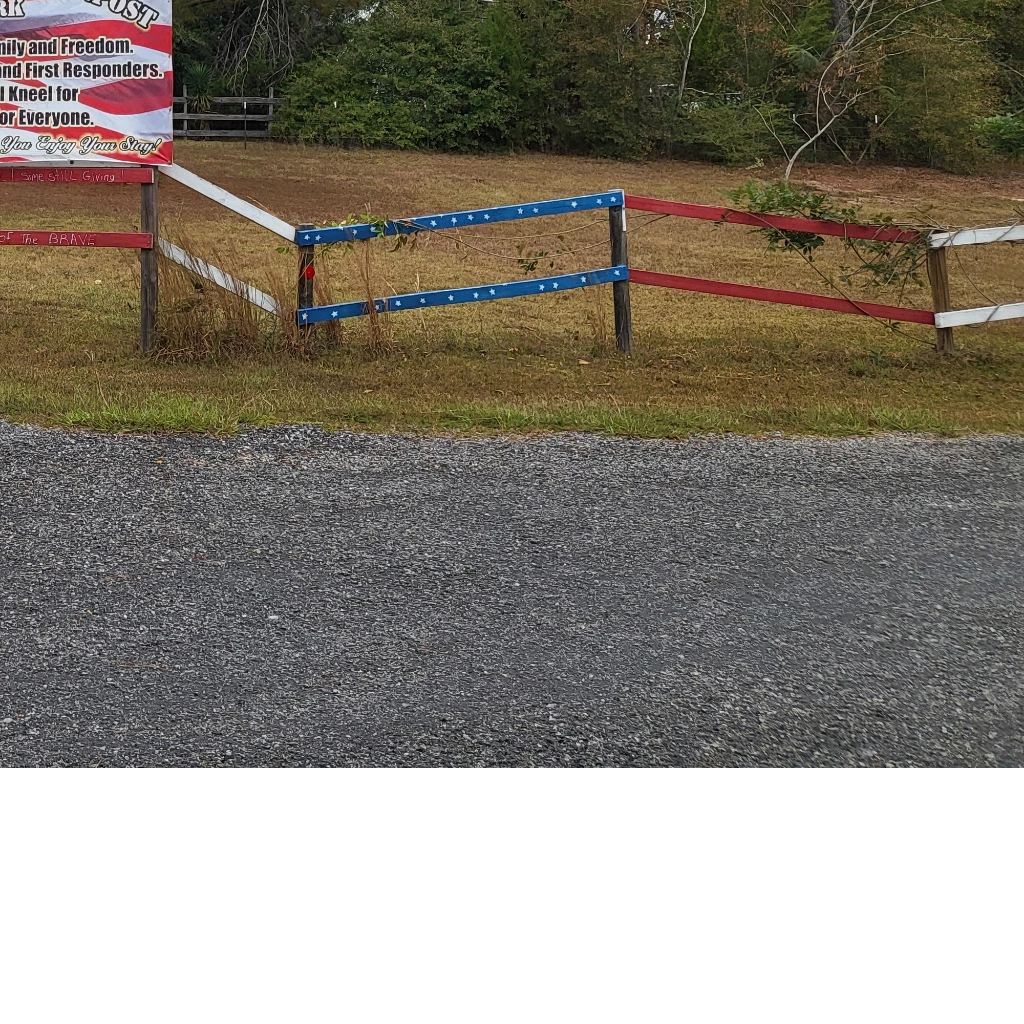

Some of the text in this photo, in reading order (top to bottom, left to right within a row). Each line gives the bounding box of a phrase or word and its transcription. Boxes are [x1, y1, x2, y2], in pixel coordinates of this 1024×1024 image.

[29, 38, 57, 55] and
[61, 38, 134, 54] Freedom.
[27, 62, 60, 78] First
[63, 62, 163, 80] Responders.
[0, 86, 4, 102] I
[9, 86, 53, 102] Kneel
[56, 86, 80, 101] for
[19, 109, 94, 126] Everyone.
[0, 136, 33, 154] You
[36, 136, 76, 154] Enjoy
[79, 136, 117, 154] Your
[119, 136, 163, 154] Stay!
